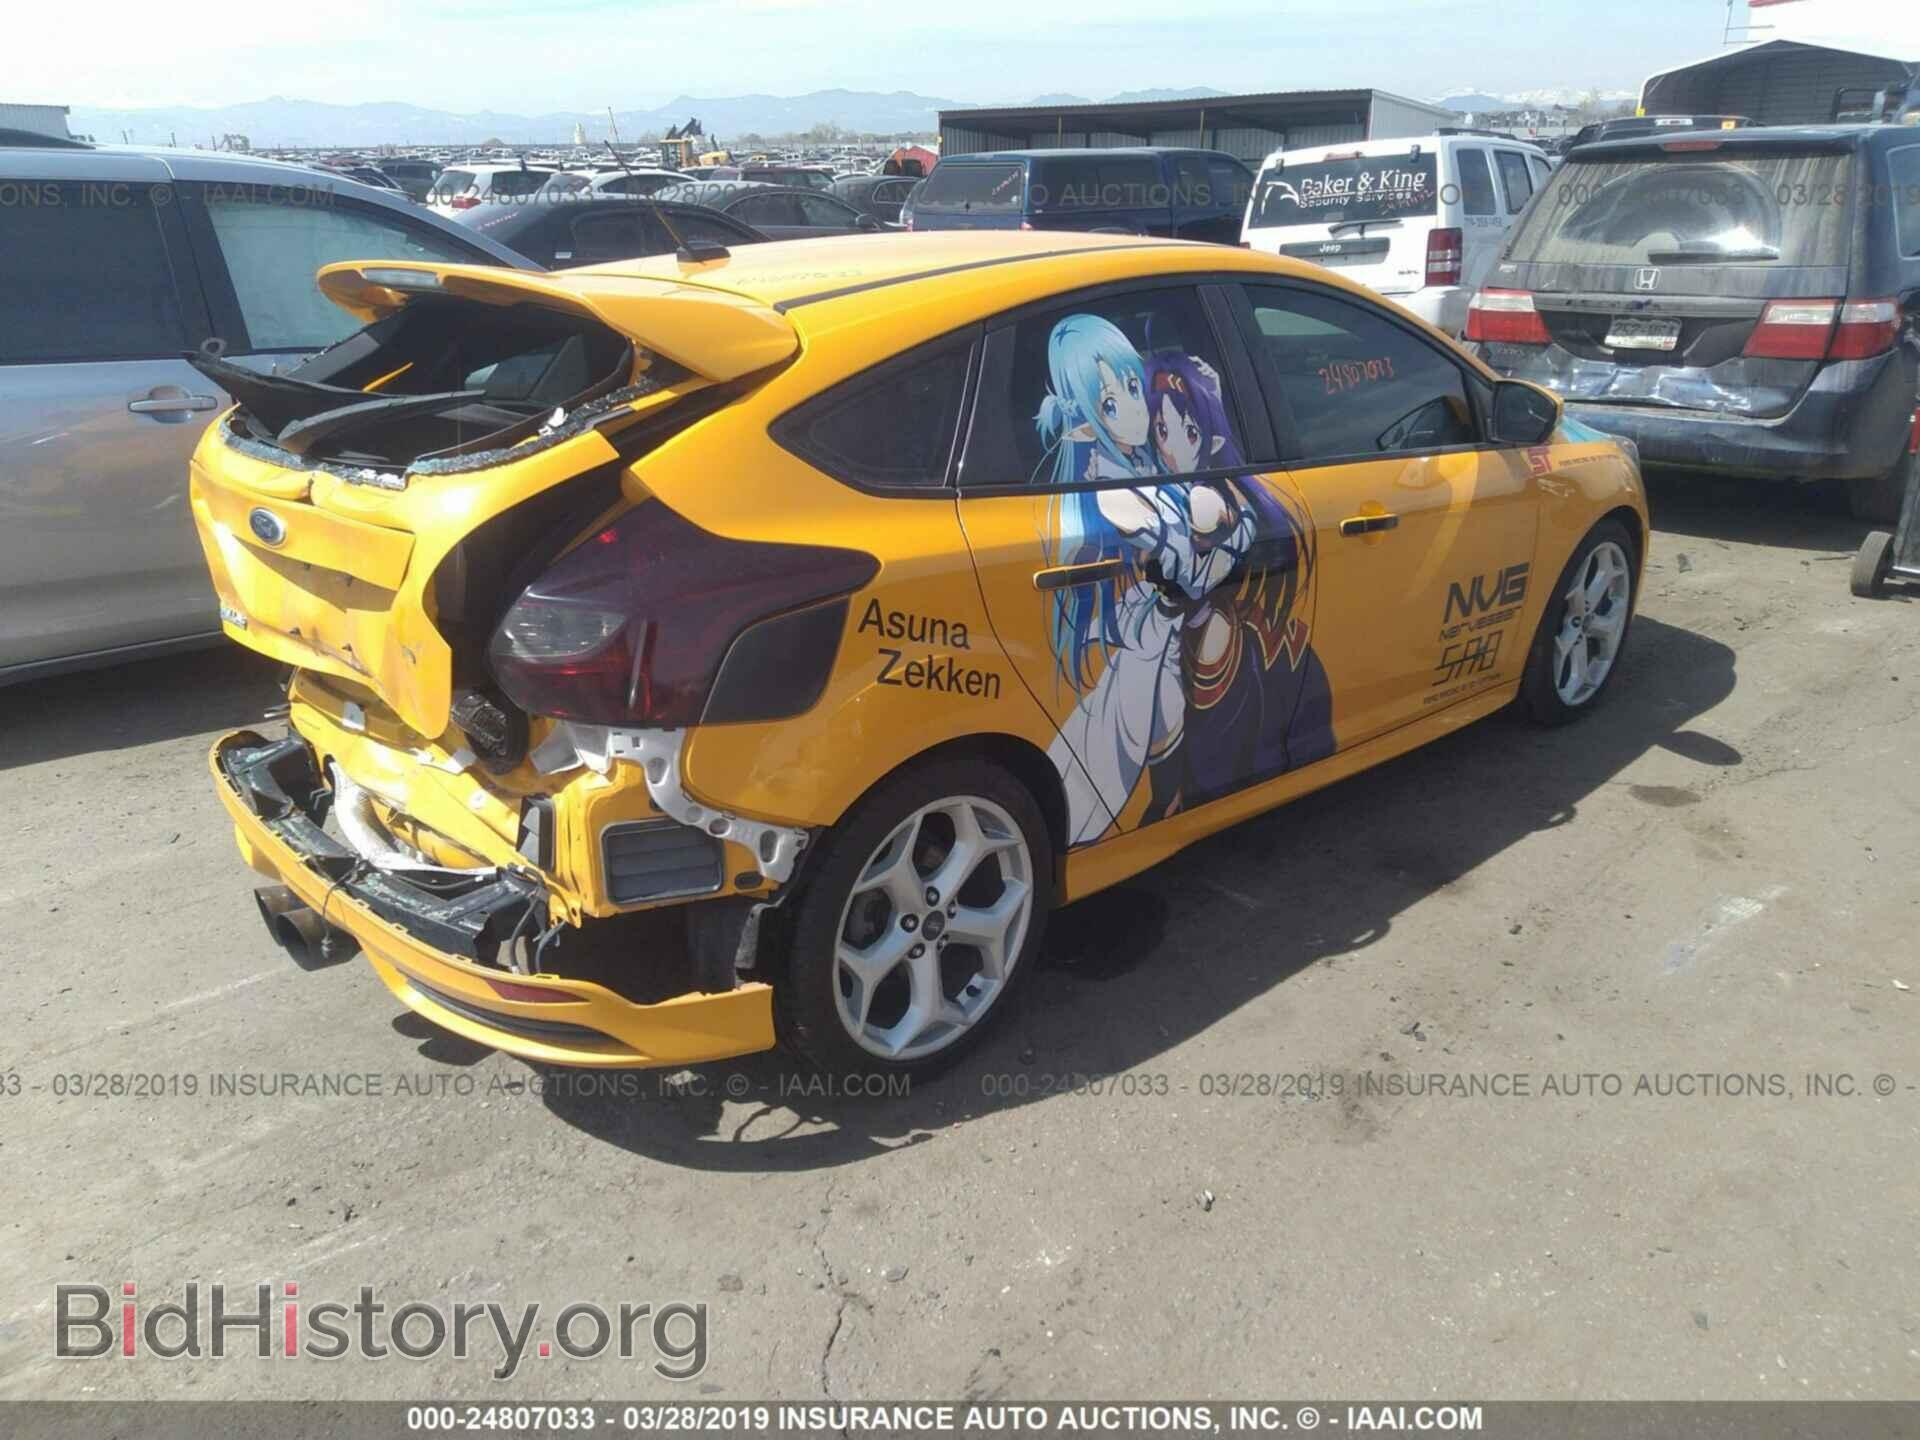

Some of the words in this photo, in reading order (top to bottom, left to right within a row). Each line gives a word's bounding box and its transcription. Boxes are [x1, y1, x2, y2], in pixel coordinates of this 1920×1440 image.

[1357, 171, 1375, 191] &
[1379, 169, 1427, 191] King
[1319, 243, 1342, 253] Jeep
[857, 598, 970, 650] Asuna
[877, 648, 1000, 700] Zekken
